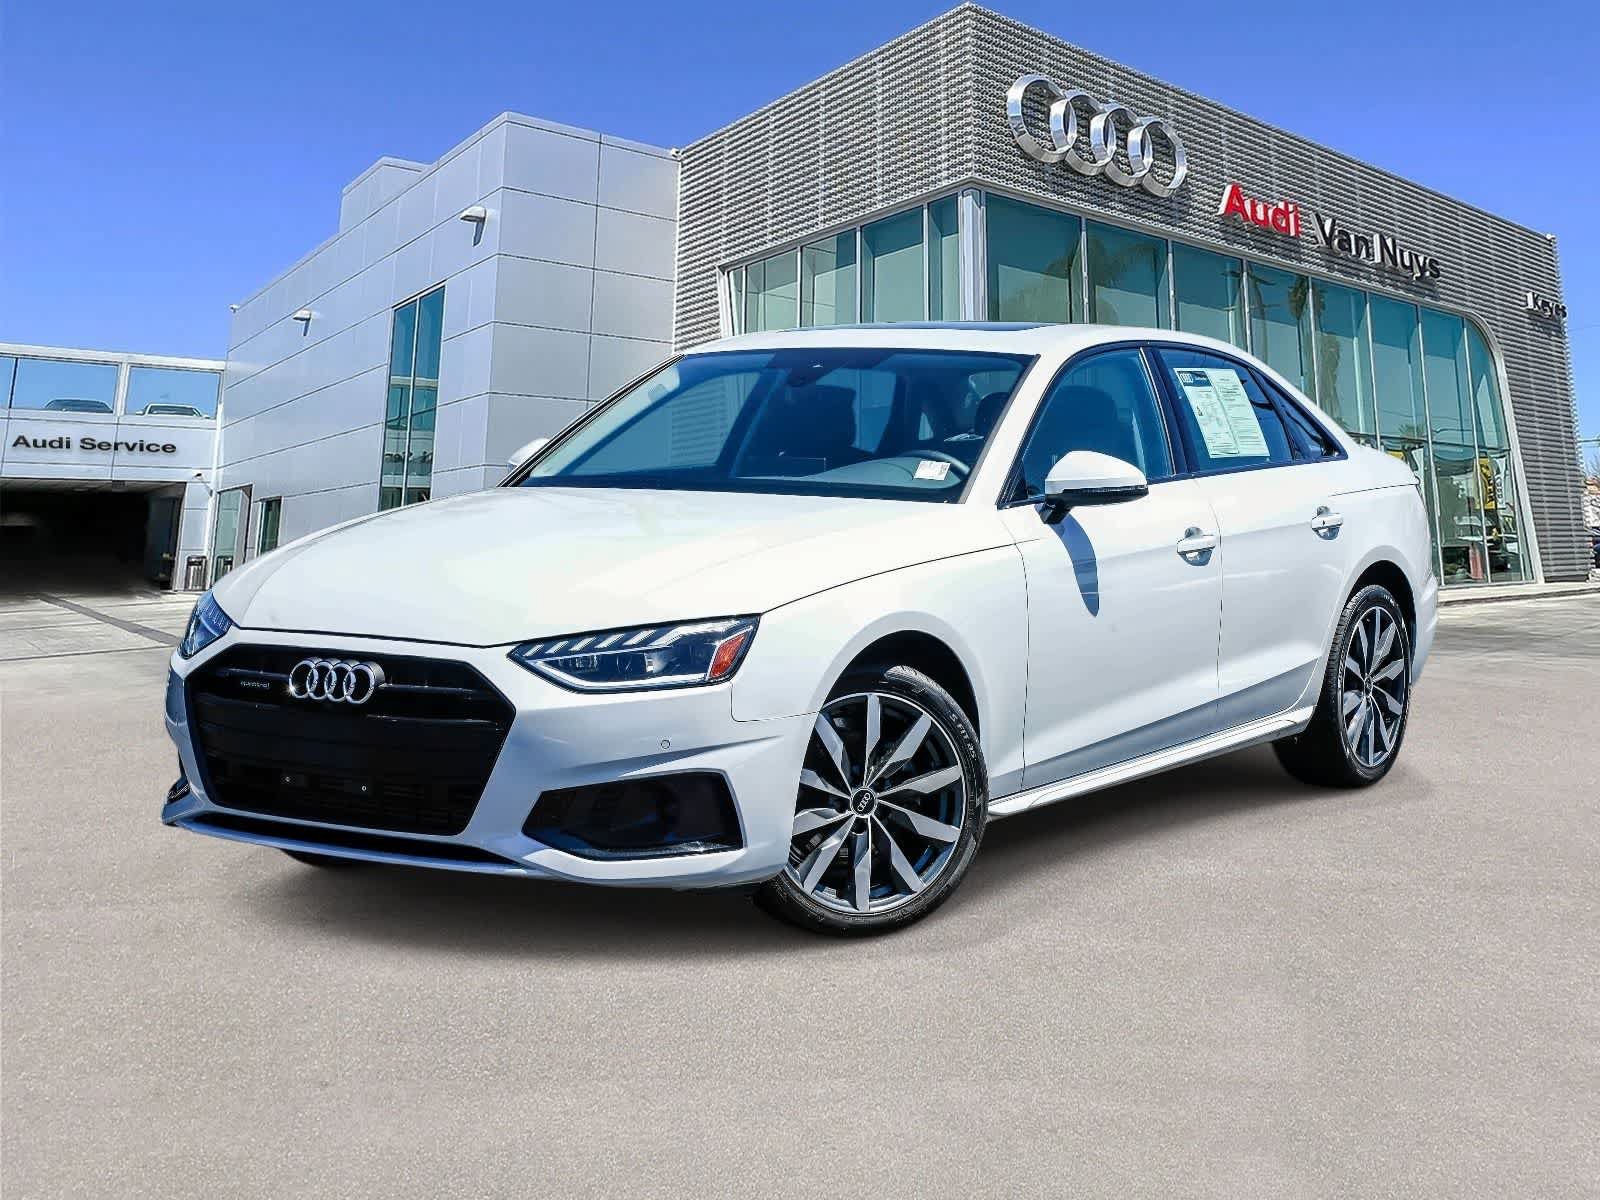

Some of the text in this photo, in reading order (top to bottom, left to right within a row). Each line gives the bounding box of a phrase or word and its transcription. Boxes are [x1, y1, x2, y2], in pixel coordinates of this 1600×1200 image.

[1219, 182, 1441, 280] Audi Van Nuys
[1526, 291, 1567, 319] Keyes
[12, 435, 177, 453] Audi Service
